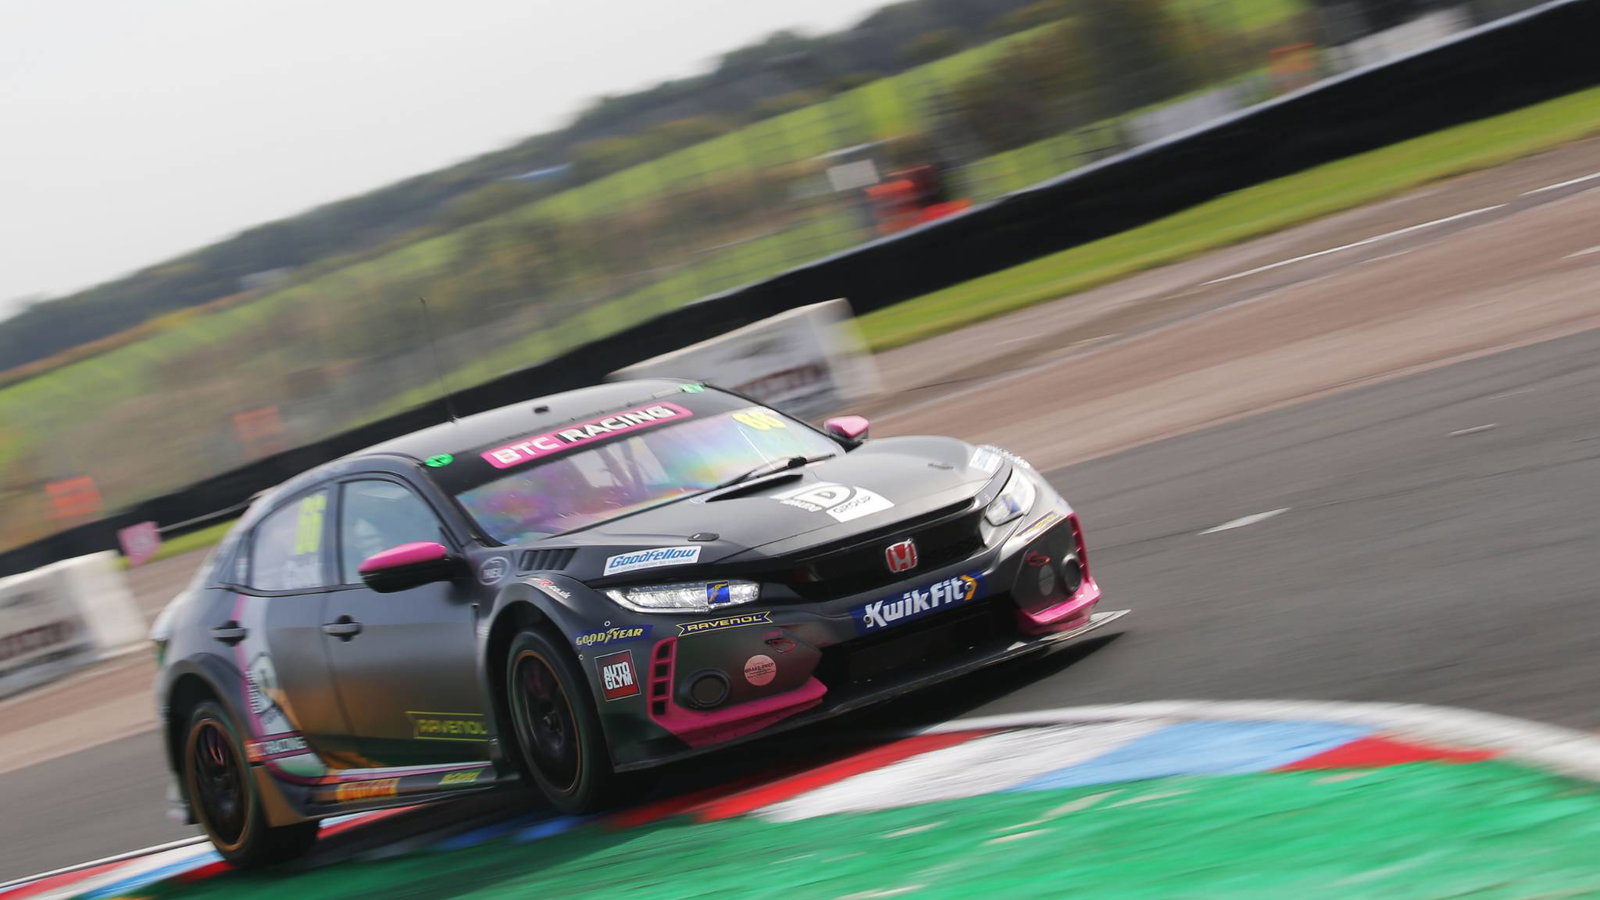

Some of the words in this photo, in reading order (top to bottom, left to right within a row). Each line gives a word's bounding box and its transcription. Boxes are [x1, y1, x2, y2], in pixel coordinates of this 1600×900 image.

[491, 437, 560, 465] BTC
[558, 405, 677, 443] RACING
[608, 548, 697, 569] GoodFellow
[687, 614, 763, 632] RAVENOL
[603, 661, 631, 679] AUTO
[605, 672, 634, 690] GLYM
